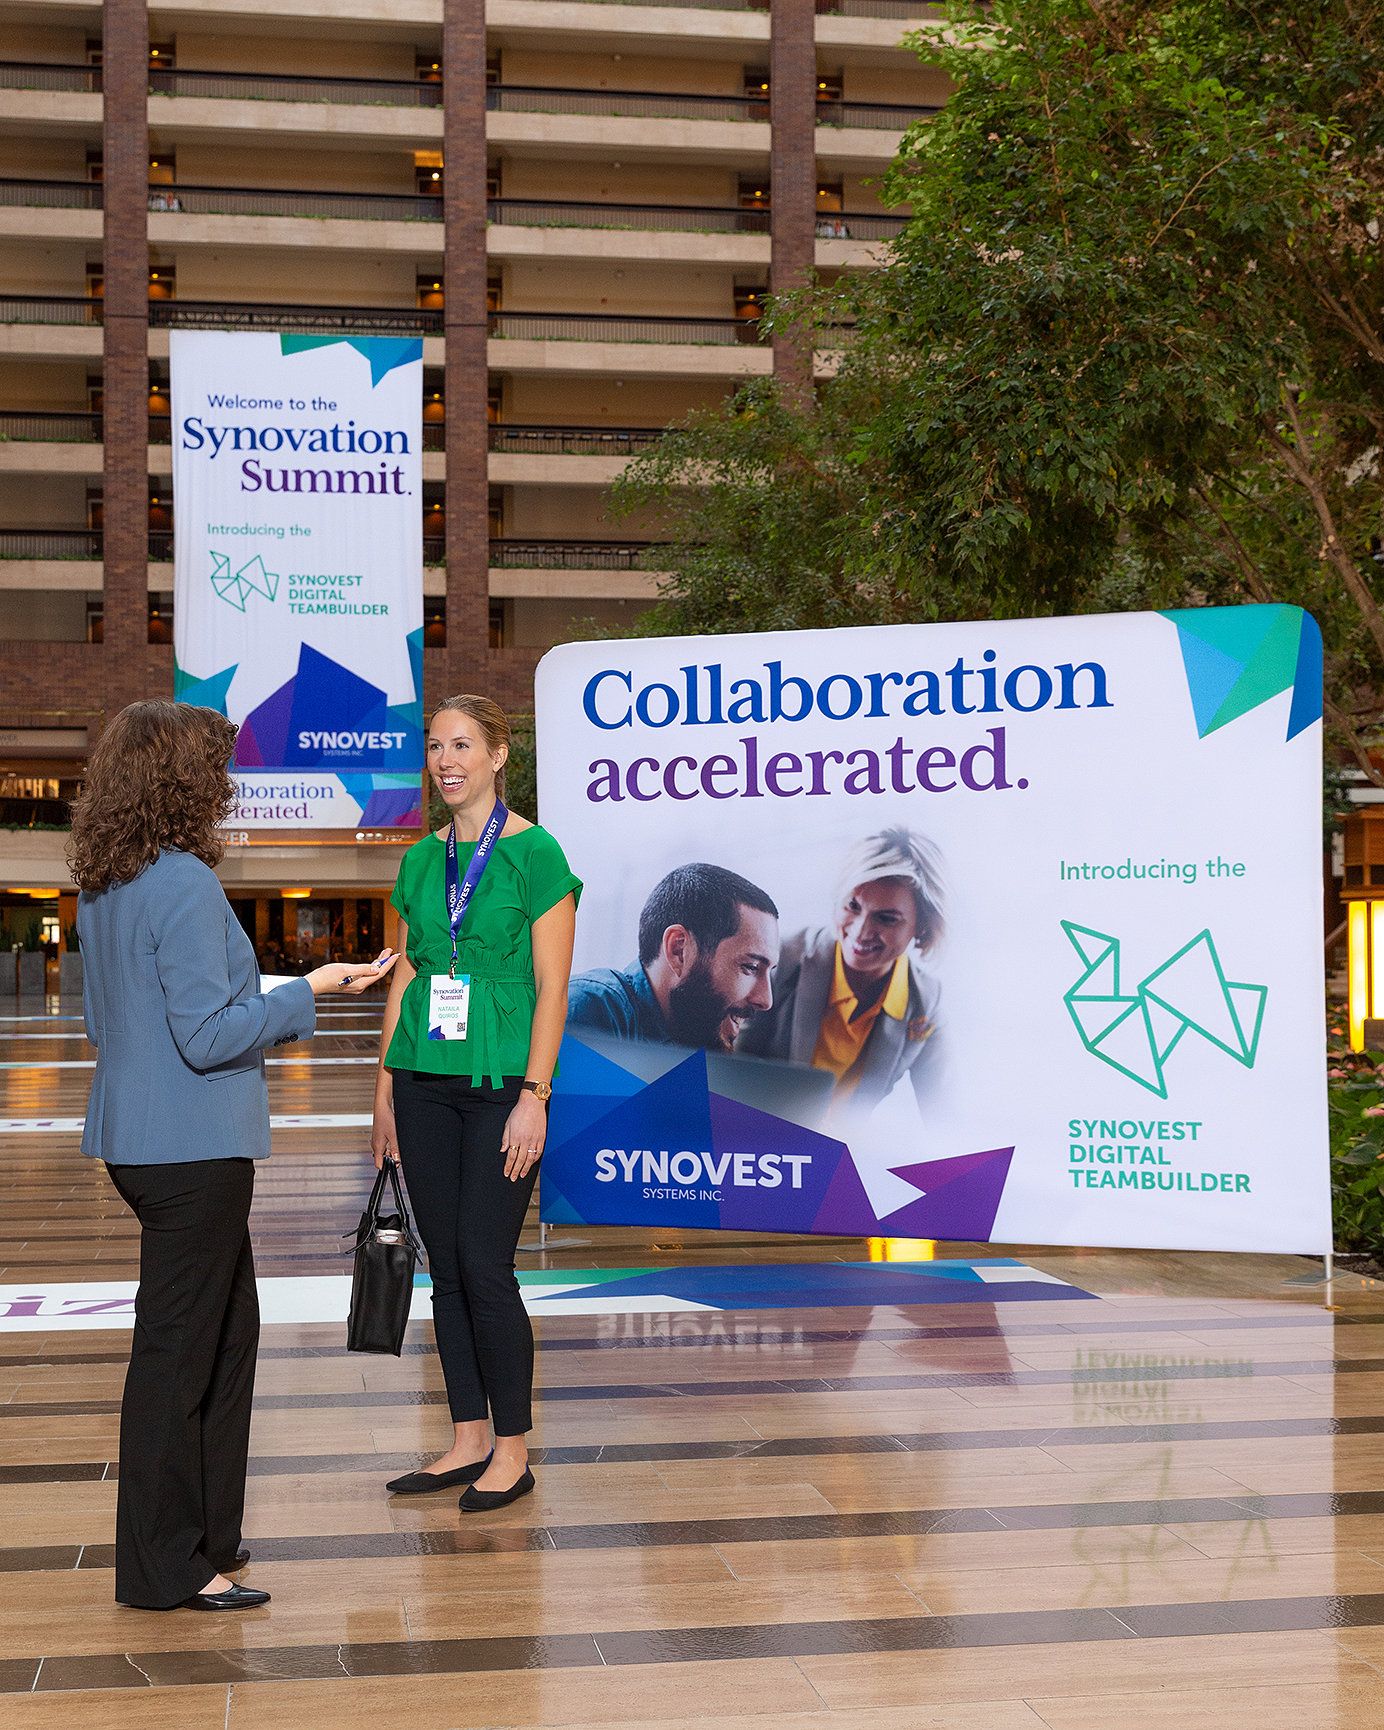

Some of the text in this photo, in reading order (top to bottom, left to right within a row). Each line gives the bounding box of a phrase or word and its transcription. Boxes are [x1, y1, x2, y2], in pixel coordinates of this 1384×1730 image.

[208, 394, 337, 411] Welcome to the
[182, 417, 411, 459] Synovation
[241, 459, 412, 496] Summit.
[207, 523, 312, 539] Introducing the
[288, 574, 363, 587] SYNOVEST
[289, 589, 346, 600] DIGITAL
[288, 603, 389, 615] TEAMBUILDER
[582, 648, 1115, 730] Collaboration
[298, 731, 407, 750] SYNOVEST
[585, 726, 1030, 803] accelerated.
[477, 817, 499, 857] SYNOVEST
[1060, 855, 1246, 884] Introducing the
[1068, 1119, 1203, 1141] SYNOVEST
[1069, 1144, 1171, 1165] DIGITAL
[594, 1148, 812, 1189] SYNOVEST
[1068, 1169, 1252, 1193] TEAMBUILDER
[642, 1188, 725, 1202] SYSTEMS INC.
